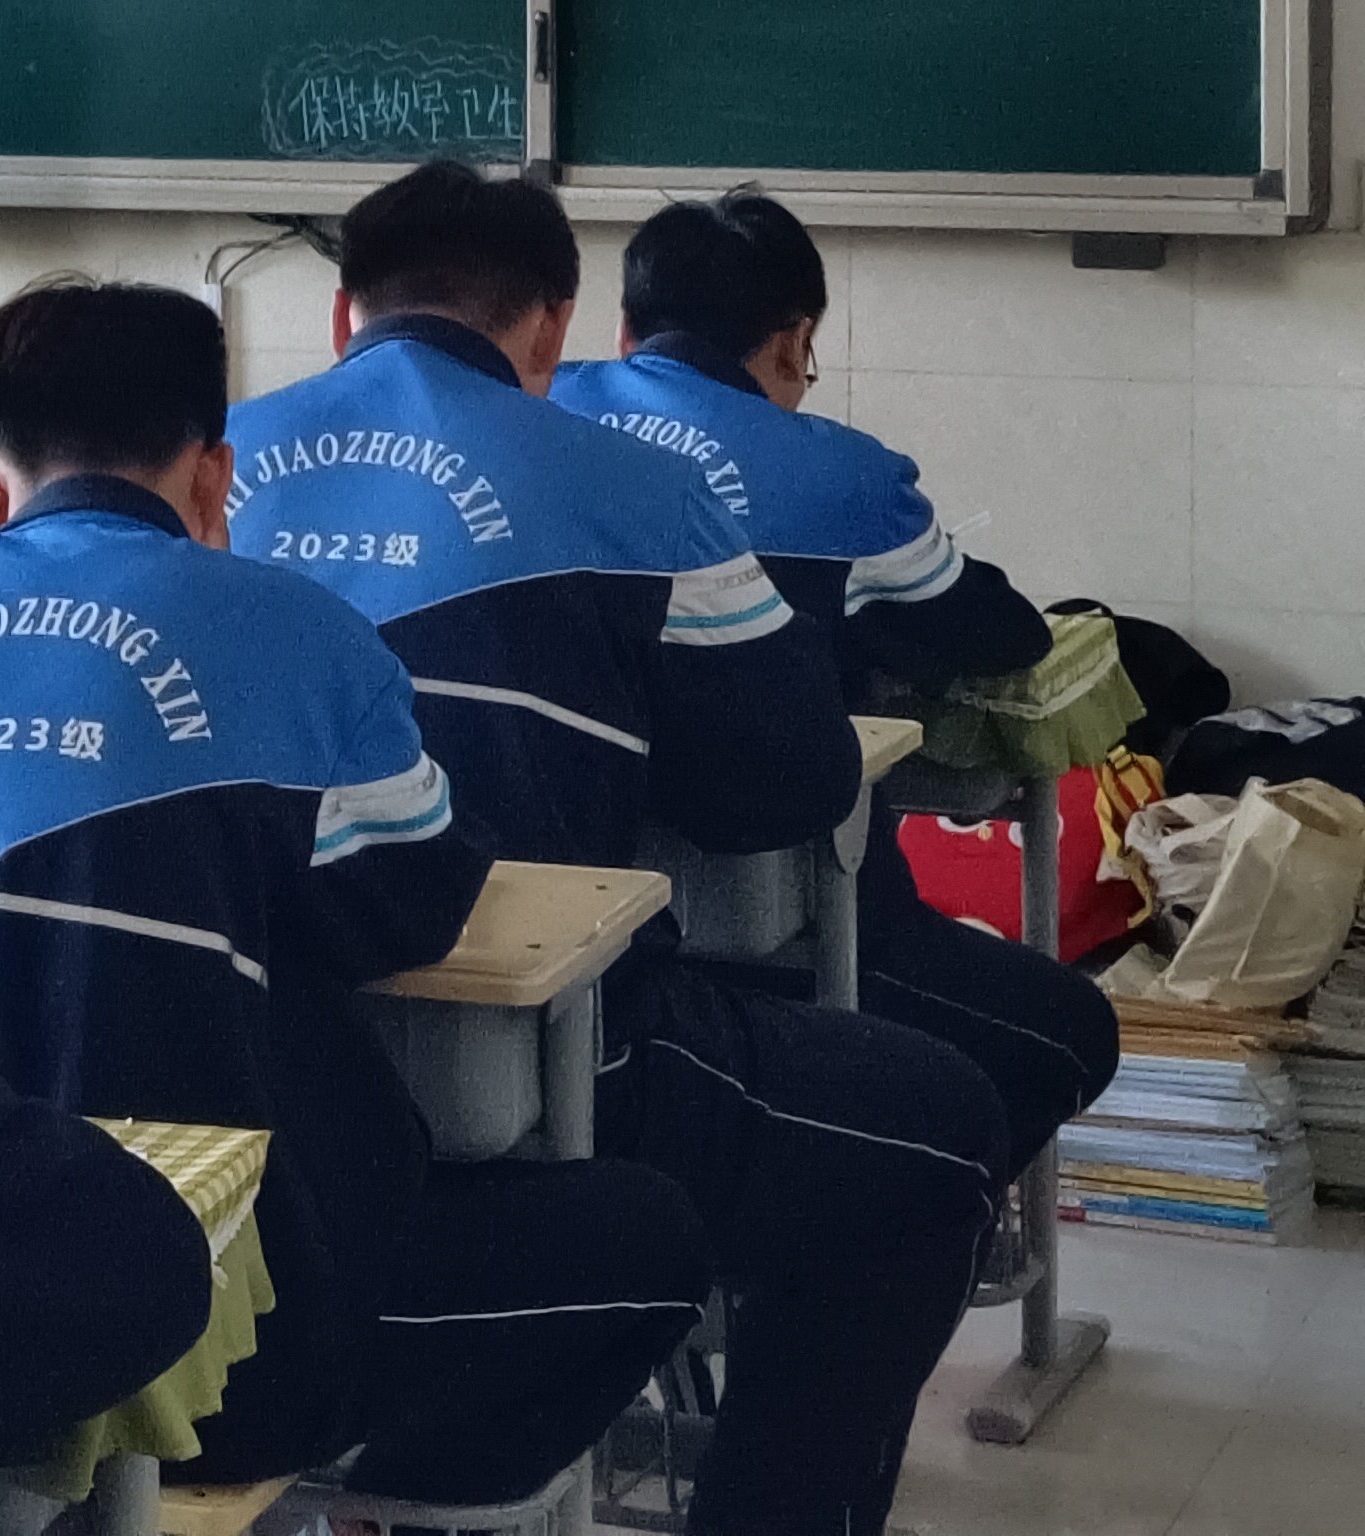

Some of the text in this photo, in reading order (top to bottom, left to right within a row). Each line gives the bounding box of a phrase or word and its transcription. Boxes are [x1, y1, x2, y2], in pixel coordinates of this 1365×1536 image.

[223, 470, 255, 519] HI
[448, 474, 514, 544] XIN
[271, 531, 420, 568] 2023级
[141, 657, 213, 744] XIN
